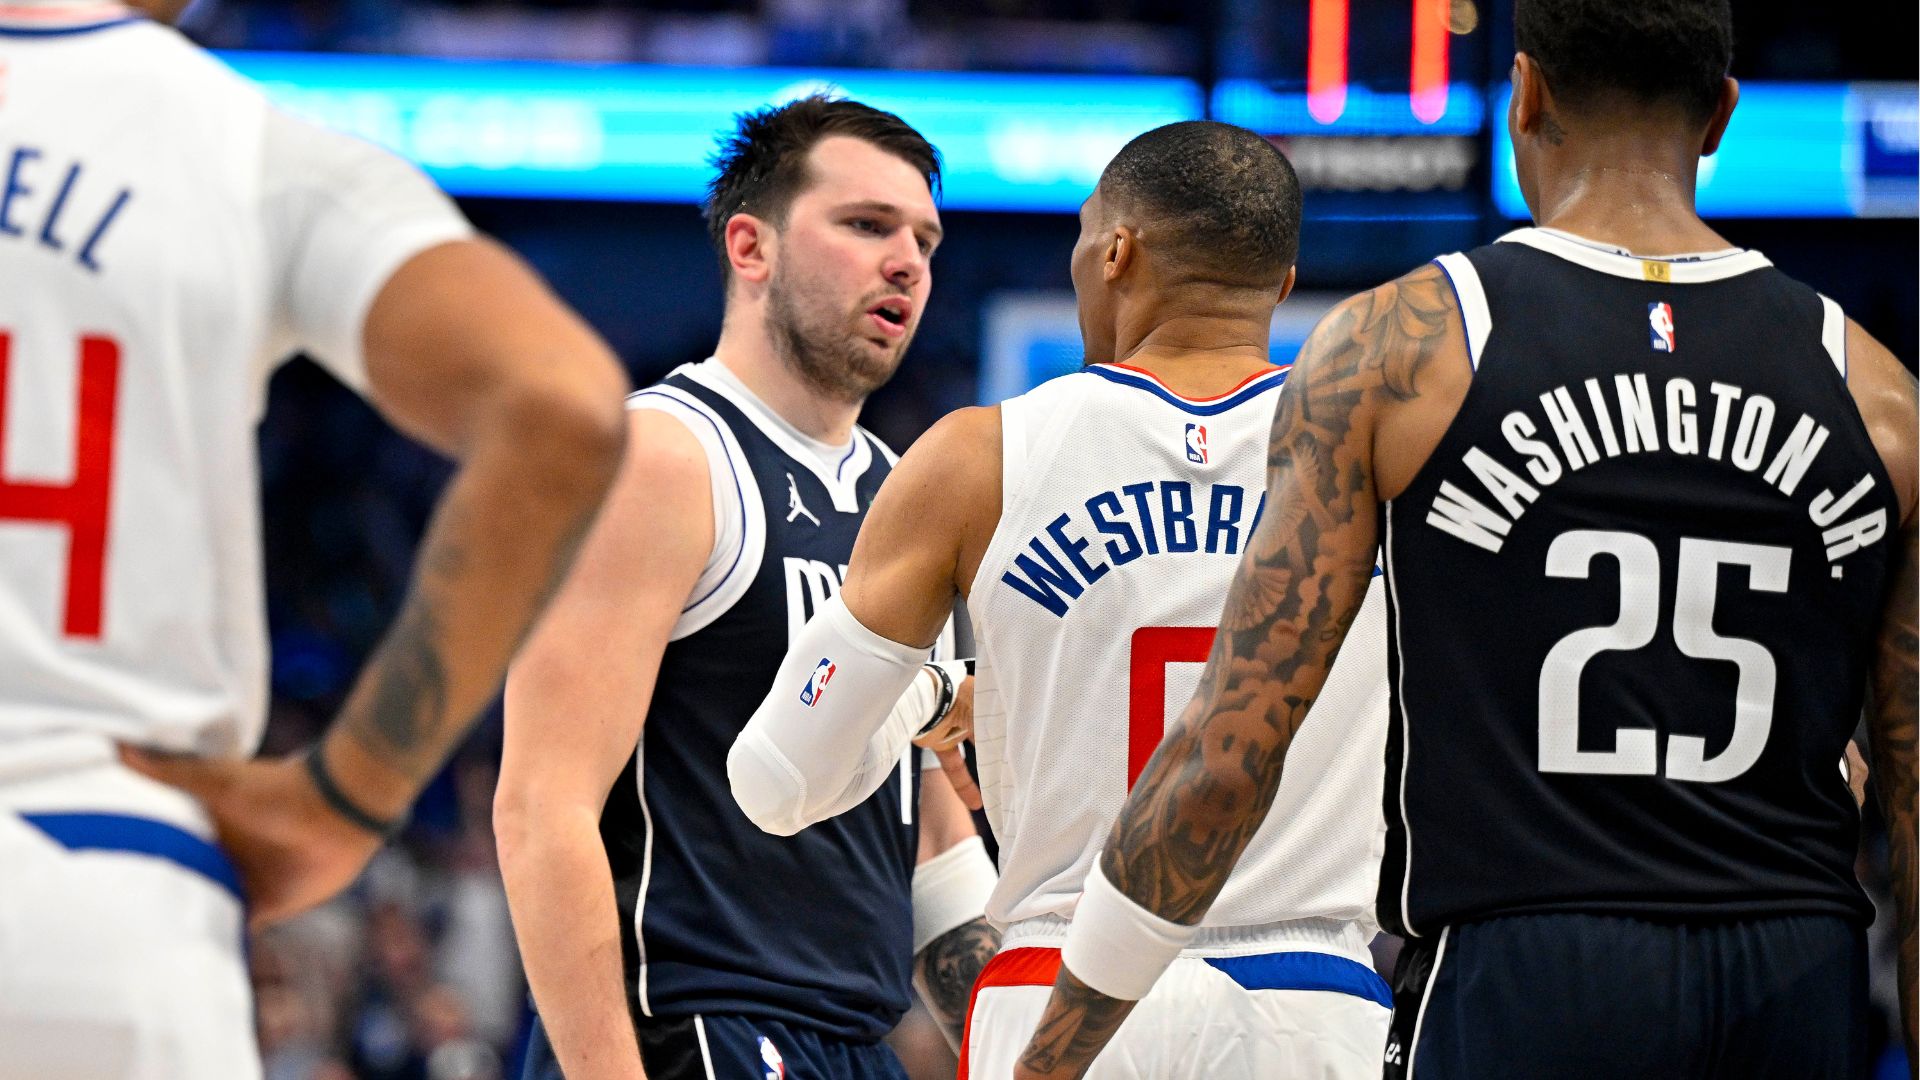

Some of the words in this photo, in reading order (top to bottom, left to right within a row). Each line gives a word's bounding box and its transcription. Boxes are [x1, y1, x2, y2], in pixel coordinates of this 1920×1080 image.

[1426, 373, 1830, 553] WASHINGTON
[1808, 473, 1887, 581] JR.
[1538, 529, 1793, 782] 25
